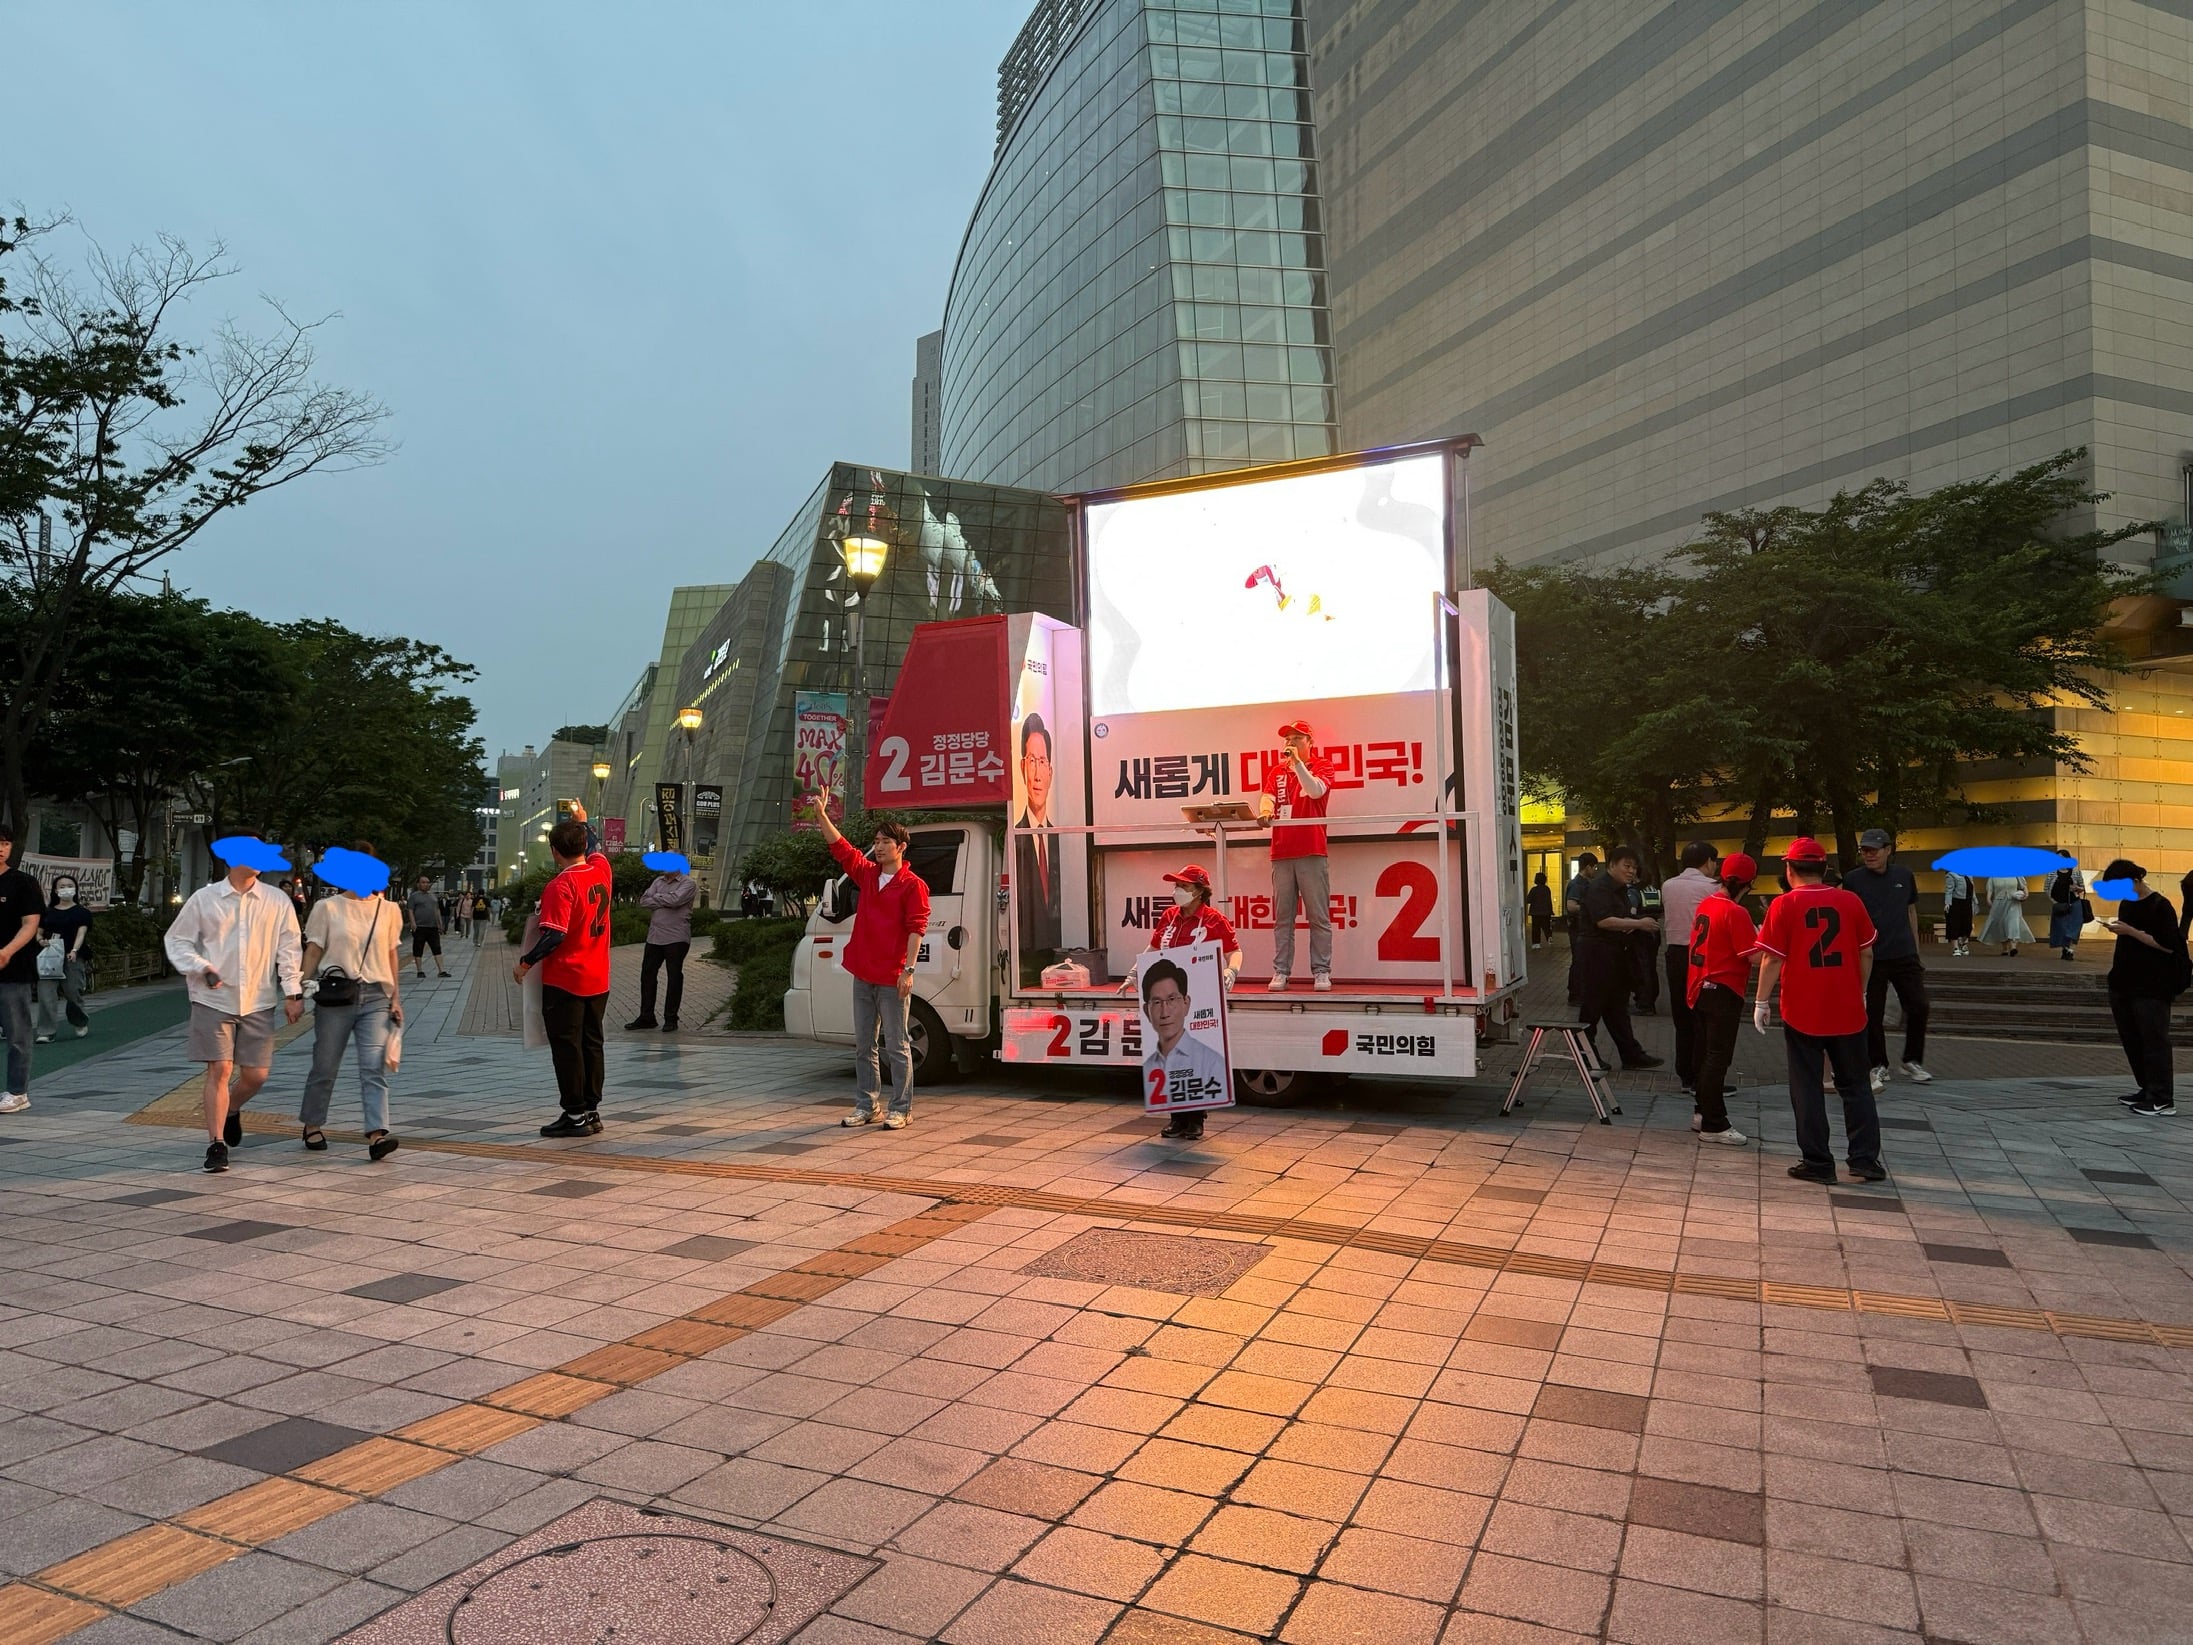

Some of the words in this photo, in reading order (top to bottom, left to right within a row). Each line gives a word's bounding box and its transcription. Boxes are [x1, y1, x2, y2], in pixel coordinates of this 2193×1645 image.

[803, 713, 837, 722] TOGETHER
[797, 728, 843, 751] MAX
[933, 731, 989, 751] 정정당당
[795, 751, 845, 790] 40%
[879, 736, 912, 793] 2
[920, 750, 1005, 787] 김문수
[1114, 752, 1230, 800] 새롭게
[1240, 741, 1424, 793] 대민국!
[1503, 688, 1518, 885] 김문수
[588, 883, 609, 937] 2
[1226, 894, 1358, 930] 대한국!
[1375, 861, 1441, 962] 2
[1690, 913, 1711, 967] 2
[1805, 906, 1842, 968] 2
[1189, 1019, 1219, 1031] 대한민국!
[1193, 1008, 1214, 1020] 새롭게
[1046, 1015, 1072, 1057] 2
[1079, 1018, 1143, 1057] 김문
[1356, 1034, 1436, 1057] 국민의힘
[1149, 1068, 1168, 1106] 2
[1170, 1076, 1222, 1103] 김문수
